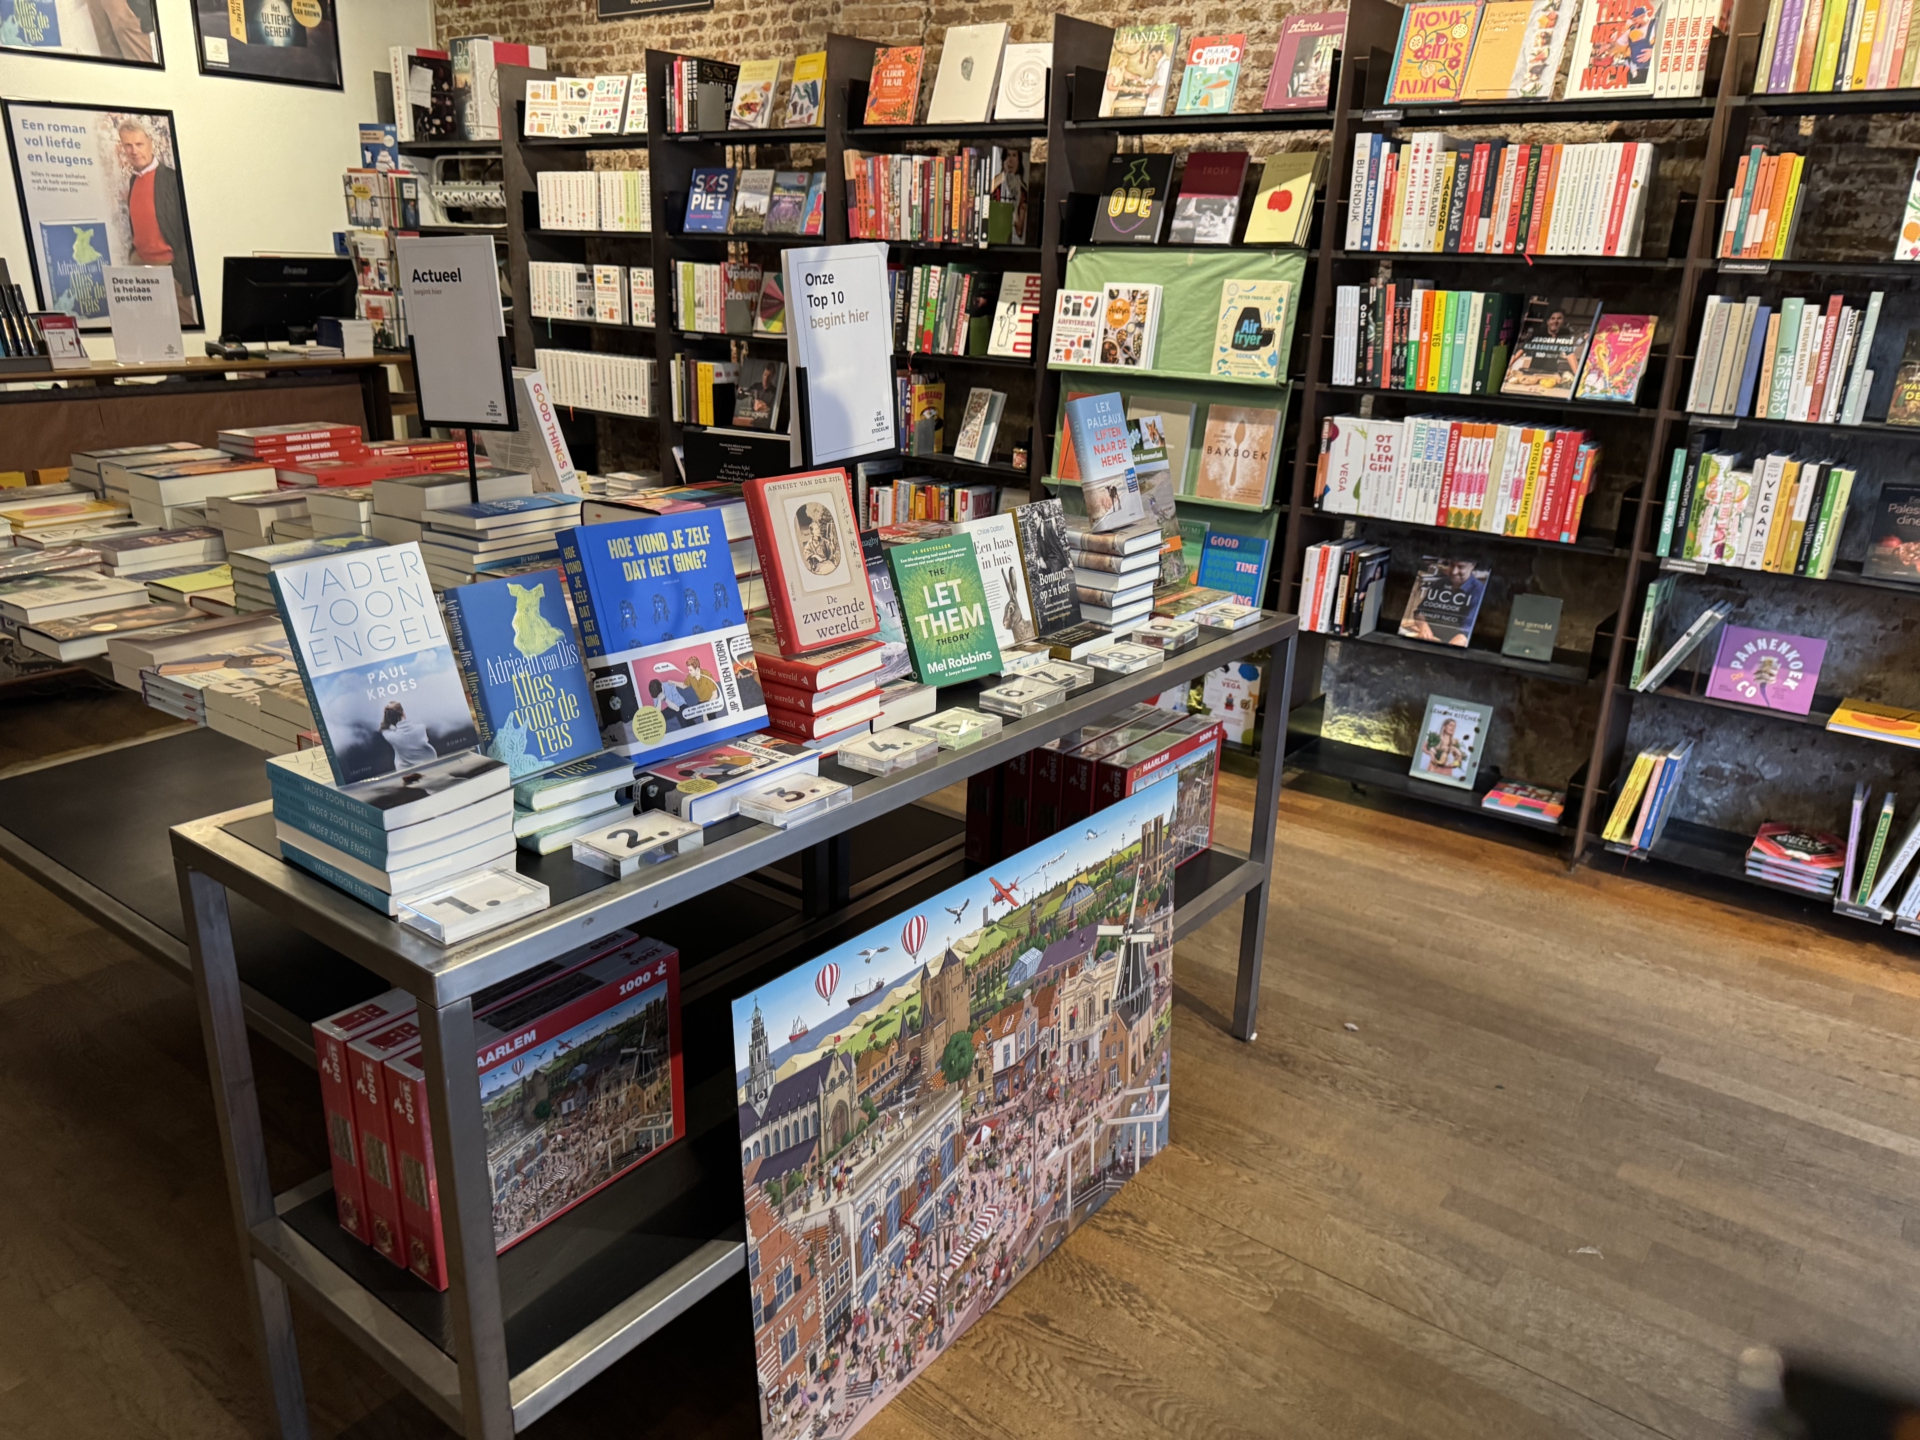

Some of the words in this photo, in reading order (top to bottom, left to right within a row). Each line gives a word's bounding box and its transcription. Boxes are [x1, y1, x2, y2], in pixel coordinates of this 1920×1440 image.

[270, 3, 281, 13] Het
[261, 13, 292, 27] ULTIEME
[1664, 18, 1676, 38] THUIS
[1677, 17, 1689, 38] THUIS
[264, 24, 292, 38] GEHEIM
[1661, 39, 1671, 55] MET
[1674, 38, 1684, 54] MET
[1203, 56, 1229, 66] SOEP
[1659, 55, 1669, 73] NICK
[1671, 54, 1682, 72] NICK
[882, 69, 908, 79] CURRY
[1579, 65, 1630, 91] NICK
[21, 119, 45, 131] Een
[48, 121, 87, 134] roman
[24, 136, 43, 147] vol
[46, 136, 81, 150] liefde
[27, 154, 43, 163] en
[46, 151, 93, 167] leugens
[1369, 157, 1379, 180] CHEZ
[1351, 159, 1366, 223] BIJDENDIJK
[1432, 167, 1443, 196] HOME
[1512, 165, 1526, 203] Persiana
[690, 194, 726, 211] PIET
[1364, 179, 1376, 226] BIJDENDIJK
[1438, 176, 1452, 232] JAARROND
[1531, 164, 1550, 227] REPERTOIRE
[1428, 197, 1439, 227] BAKED
[1509, 204, 1519, 229] EASY
[112, 277, 134, 286] Deze
[135, 277, 160, 285] kassa
[412, 267, 462, 284] Actueel
[805, 272, 835, 287] Onze
[113, 285, 121, 293] is
[122, 285, 151, 294] helaas
[114, 294, 153, 303] gesloten
[414, 288, 431, 296] begint
[807, 293, 828, 310] Top
[831, 291, 844, 305] 10
[895, 289, 905, 323] PADELLA
[810, 311, 847, 331] begint
[848, 308, 870, 325] hier
[1240, 319, 1259, 334] Air
[1804, 310, 1813, 326] HET
[1234, 331, 1262, 348] fryer
[1800, 327, 1811, 352] NIEUWE
[1822, 315, 1837, 351] BELGISCH
[1796, 353, 1807, 381] BAKKEN
[1815, 351, 1831, 385] BAKBOEK
[1095, 401, 1111, 413] LEX
[533, 383, 551, 422] GOOD
[546, 422, 568, 469] THINGS
[1087, 413, 1122, 429] PALEAUX
[1094, 427, 1122, 441] LIFTEN
[1376, 435, 1393, 444] OT
[1412, 422, 1427, 459] FALASTIN
[1435, 427, 1449, 462] JERUZALEM
[1093, 440, 1116, 455] NAAR
[1118, 438, 1128, 450] DE
[1206, 445, 1268, 461] BAKBOEK
[1375, 444, 1392, 453] TO
[1445, 429, 1459, 476] OTTOLENGHI
[1101, 453, 1127, 467] HEMEL
[1369, 463, 1392, 473] GHI
[1370, 453, 1392, 463] LEN
[1525, 442, 1541, 491] OTTOLENGHI
[1540, 446, 1552, 472] OTK
[1548, 439, 1564, 487] OTTOLENGHI
[767, 480, 798, 492] ANNEJET
[799, 479, 813, 488] VAN
[814, 477, 828, 486] DER
[828, 475, 842, 484] ZIJL
[1336, 462, 1351, 493] VEGA
[1681, 465, 1695, 507] GASTRONOMIE
[1440, 477, 1452, 509] FLAVOUR
[1520, 492, 1533, 520] SIMPEL
[1541, 488, 1554, 522] FLAVOUR
[1755, 480, 1776, 538] VEGAN
[1677, 507, 1687, 528] VEGAN
[977, 526, 989, 536] Chloe
[990, 524, 1004, 534] Dalton
[1811, 520, 1828, 561] EASY
[607, 535, 633, 559] HOE
[634, 531, 669, 554] VOND
[670, 529, 687, 549] JE
[686, 525, 712, 546] ZELF
[973, 541, 993, 555] Een
[993, 537, 1014, 550] haas
[1210, 535, 1239, 549] GOOD
[621, 560, 648, 583] DAT
[648, 555, 672, 577] HET
[672, 549, 708, 573] GING?
[981, 558, 990, 570] in
[993, 552, 1012, 567] huis
[1235, 561, 1259, 574] TIME
[284, 550, 421, 601] VADER
[928, 568, 945, 578] THE
[1039, 570, 1066, 586] Bomans
[762, 564, 777, 603] zwevende
[771, 602, 784, 633] wereld
[826, 595, 838, 606] De
[922, 578, 962, 609] LET
[1040, 591, 1047, 605] op
[1058, 580, 1070, 594] best
[1420, 588, 1472, 607] TUCCI
[301, 582, 424, 634] ZOON
[802, 598, 866, 625] zwevende
[1423, 601, 1461, 612] COOKBOOK
[816, 614, 860, 639] wereld
[915, 602, 986, 639] THEM
[308, 614, 442, 667] ENGEL
[936, 632, 970, 646] THEORY
[486, 651, 542, 686] Adriaan
[541, 656, 560, 673] van
[560, 641, 579, 669] Dis
[713, 639, 728, 669] TOORN
[927, 661, 947, 675] Mel
[948, 651, 993, 667] Robbins
[1730, 638, 1803, 690] PANNENKOEK
[366, 665, 408, 684] PAUL
[720, 669, 733, 684] DEN
[778, 670, 798, 682] wereld
[366, 678, 418, 701] KROES
[512, 671, 556, 708] Alles
[725, 684, 738, 701] VAN
[1222, 681, 1241, 690] VEGA
[515, 702, 557, 733] voor
[559, 688, 580, 723] de
[729, 701, 741, 713] JIP
[535, 724, 574, 757] reis
[870, 734, 910, 751] 4.
[1142, 753, 1170, 772] HAARLEM
[303, 782, 324, 798] VADER
[325, 790, 345, 807] ZOON
[346, 800, 369, 818] ENGEL
[763, 786, 820, 803] 3.
[606, 828, 670, 849] 2.
[433, 895, 501, 916] 1.
[477, 1029, 537, 1068] AARLEM
[618, 972, 652, 995] 1000
[364, 1064, 378, 1104] 1000
[401, 1083, 415, 1124] 1000
